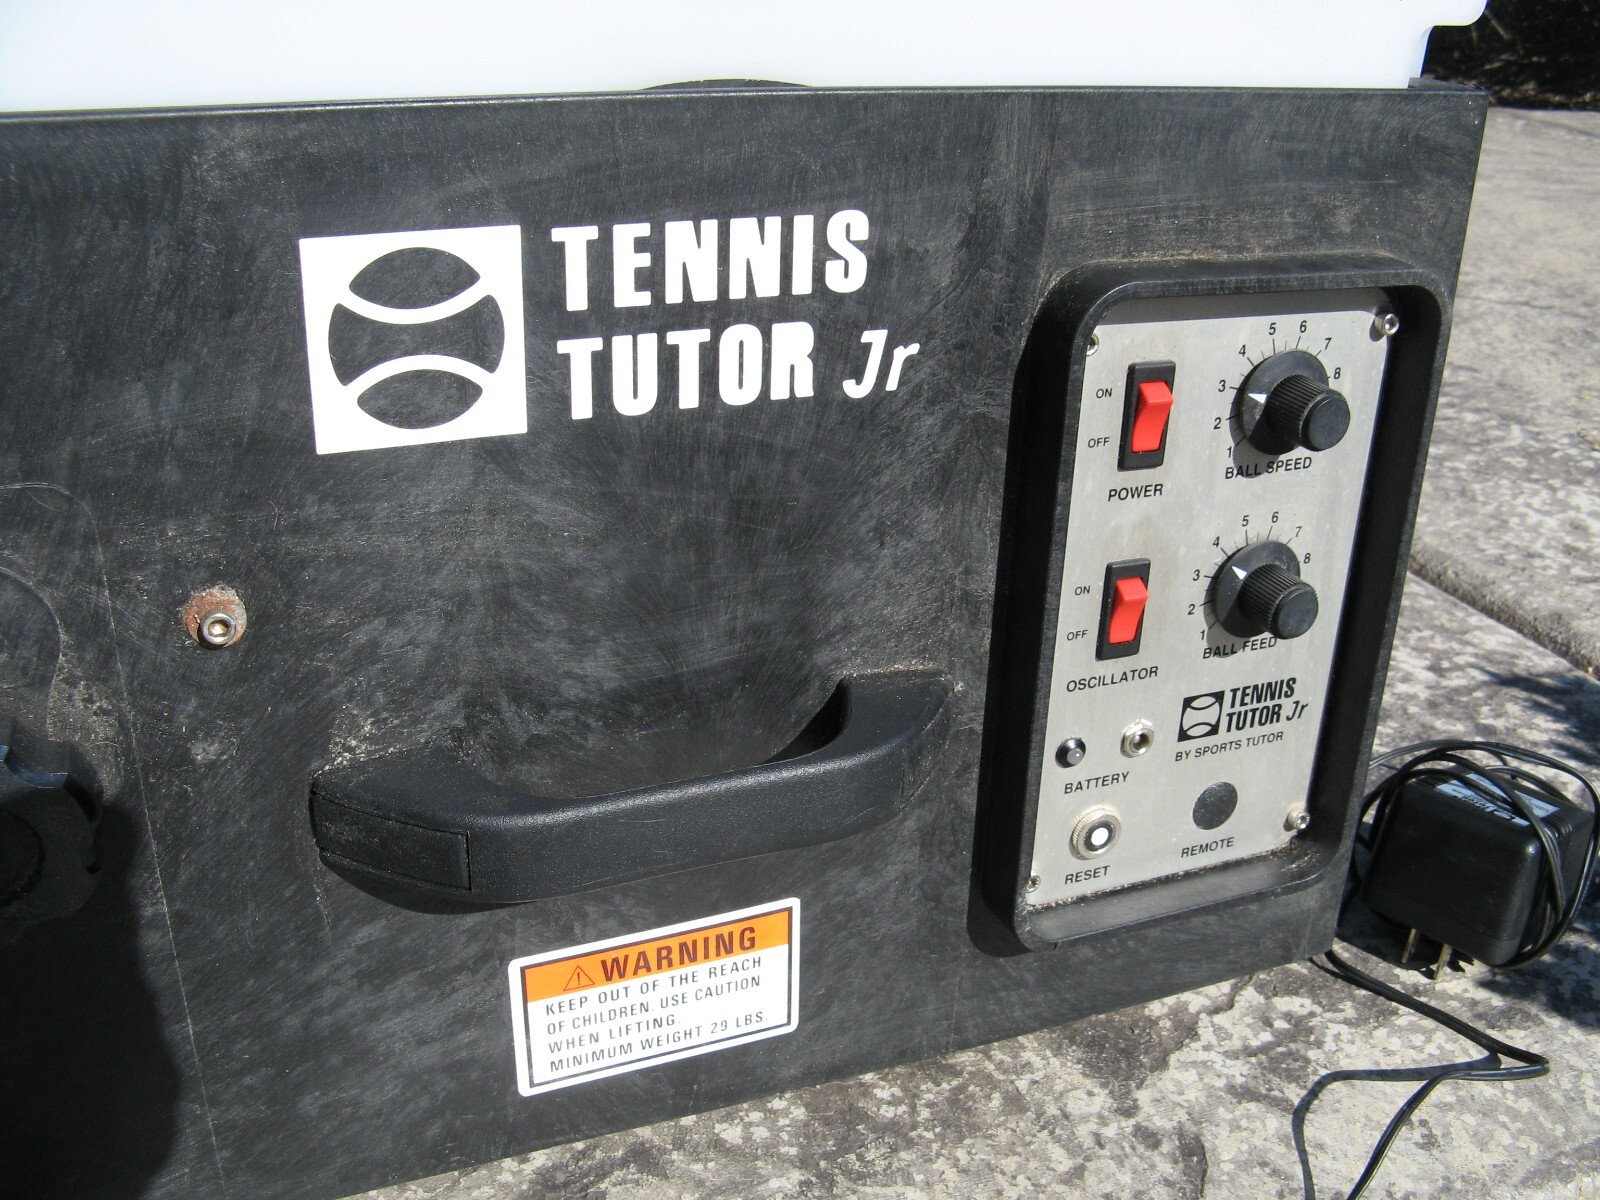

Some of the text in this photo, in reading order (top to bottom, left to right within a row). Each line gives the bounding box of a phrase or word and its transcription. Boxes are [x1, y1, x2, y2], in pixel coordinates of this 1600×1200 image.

[551, 209, 869, 312] TENNIS
[1268, 322, 1277, 336] 5
[1299, 320, 1308, 333] 6
[1324, 337, 1332, 350] 7
[1238, 344, 1246, 357] 4
[557, 321, 921, 420] TUTOR Jr
[1333, 367, 1341, 380] 8
[1218, 380, 1226, 392] 3
[1096, 387, 1113, 399] ON
[1213, 417, 1222, 430] 2
[1088, 436, 1110, 449] OFF
[1226, 446, 1232, 458] 1
[1225, 456, 1312, 480] BALL SPEED
[1107, 483, 1164, 502] POWER
[1241, 515, 1250, 527] 5
[1271, 511, 1279, 524] 6
[1295, 526, 1303, 538] 7
[1212, 536, 1220, 548] 4
[1303, 552, 1311, 564] 8
[1192, 569, 1200, 581] 3
[1074, 585, 1091, 596] ON
[1187, 603, 1196, 615] 2
[1066, 629, 1089, 641] OFF
[1200, 629, 1206, 641] 1
[1202, 636, 1278, 659] BALL FEED
[1066, 665, 1159, 693] OSCILLATOR
[1229, 677, 1297, 709] TENNIS
[1225, 700, 1309, 733] TUTOR Jr
[1174, 731, 1284, 762] BY SPORTS TUTOR
[1063, 771, 1130, 795] BATTERY
[1180, 836, 1235, 858] REMOTE
[1064, 865, 1111, 885] RESET
[600, 926, 756, 983] WARNING
[545, 956, 762, 1016] KEEP OUT OF THE REACH
[547, 1020, 565, 1035] OF
[660, 991, 689, 1009] USE
[695, 975, 761, 1001] CAUTION
[548, 1031, 600, 1054] WHEN
[550, 1042, 633, 1073] MINIMUM
[640, 1025, 703, 1050] WEIGHT
[710, 1019, 728, 1034] 29
